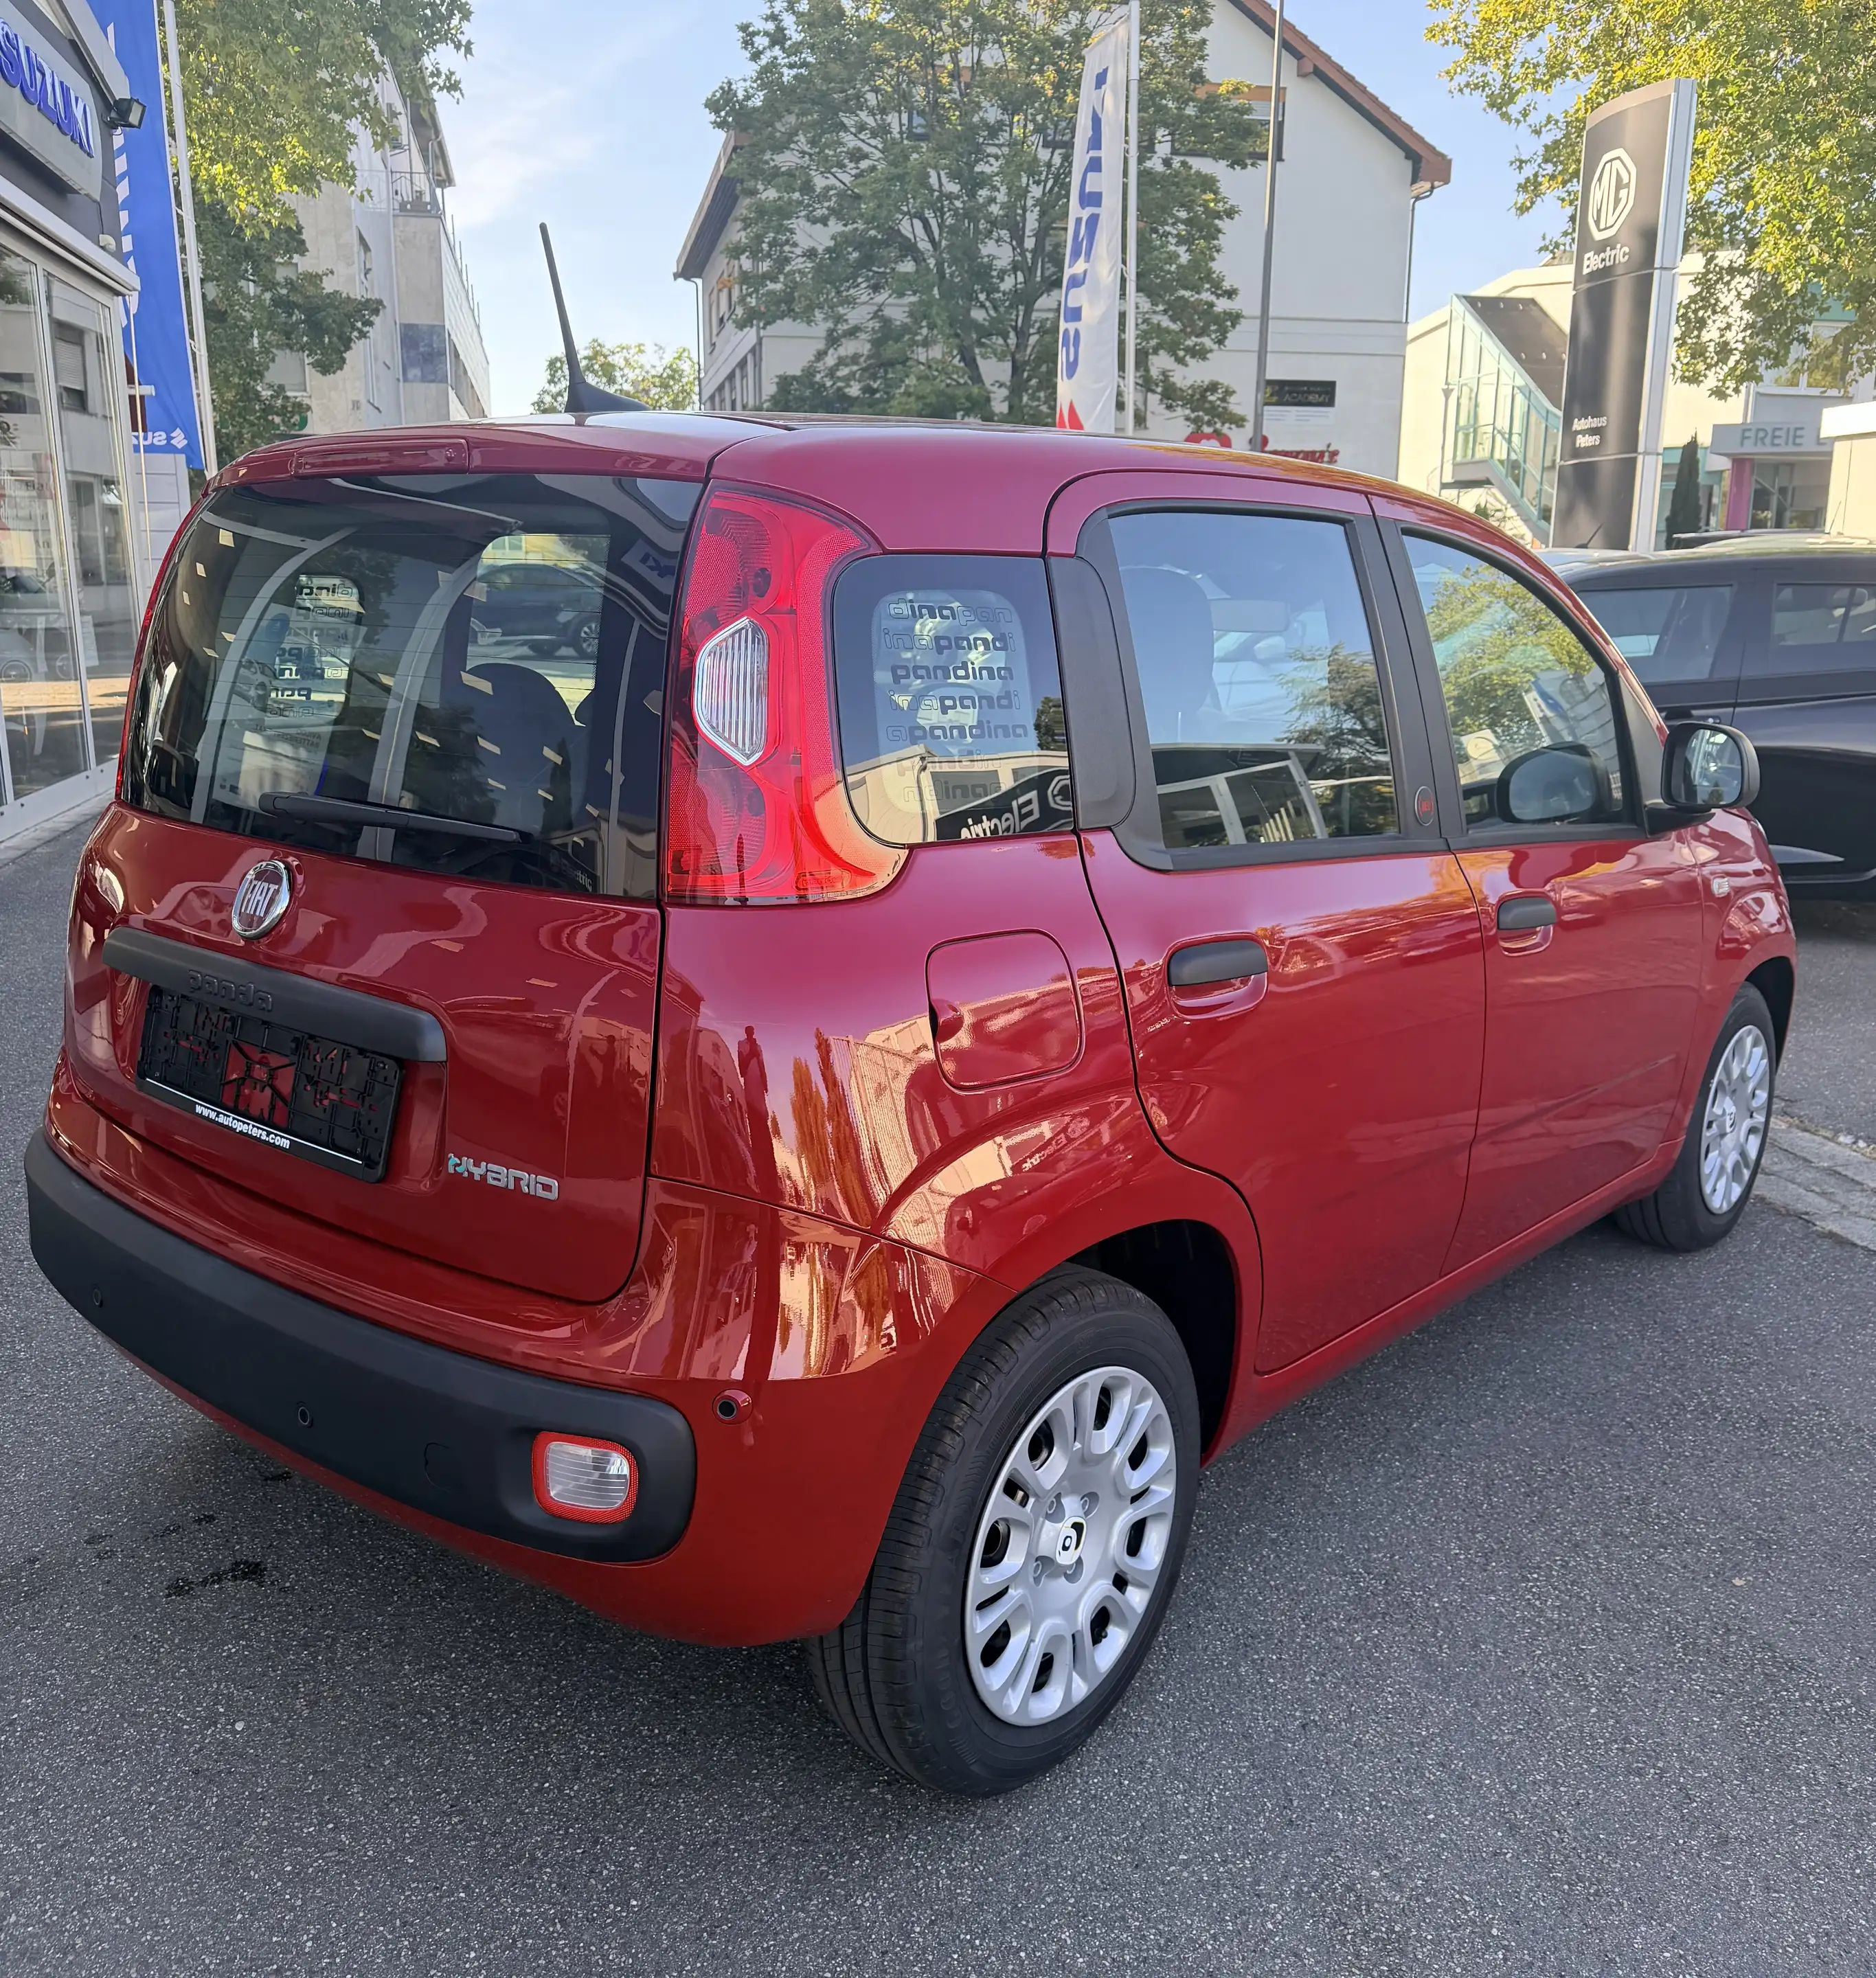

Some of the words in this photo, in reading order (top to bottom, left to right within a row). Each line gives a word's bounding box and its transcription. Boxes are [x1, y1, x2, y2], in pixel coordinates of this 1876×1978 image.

[0, 17, 95, 159] SUZUKI
[1591, 159, 1631, 230] MG
[1583, 242, 1630, 275] Electric
[1282, 392, 1331, 404] ACADEMY
[1571, 415, 1608, 432] Autohaus
[1739, 426, 1806, 448] FREIE
[1575, 433, 1601, 448] Peters
[888, 598, 1013, 626] dinapan
[882, 627, 1017, 655] inapandi
[890, 660, 1015, 685] pandina
[888, 689, 1021, 716] inapandi
[241, 880, 279, 917] FIAT
[188, 969, 273, 1012] panda
[195, 1104, 291, 1149] www.autopeters.com
[447, 1152, 559, 1201] HYBRID
